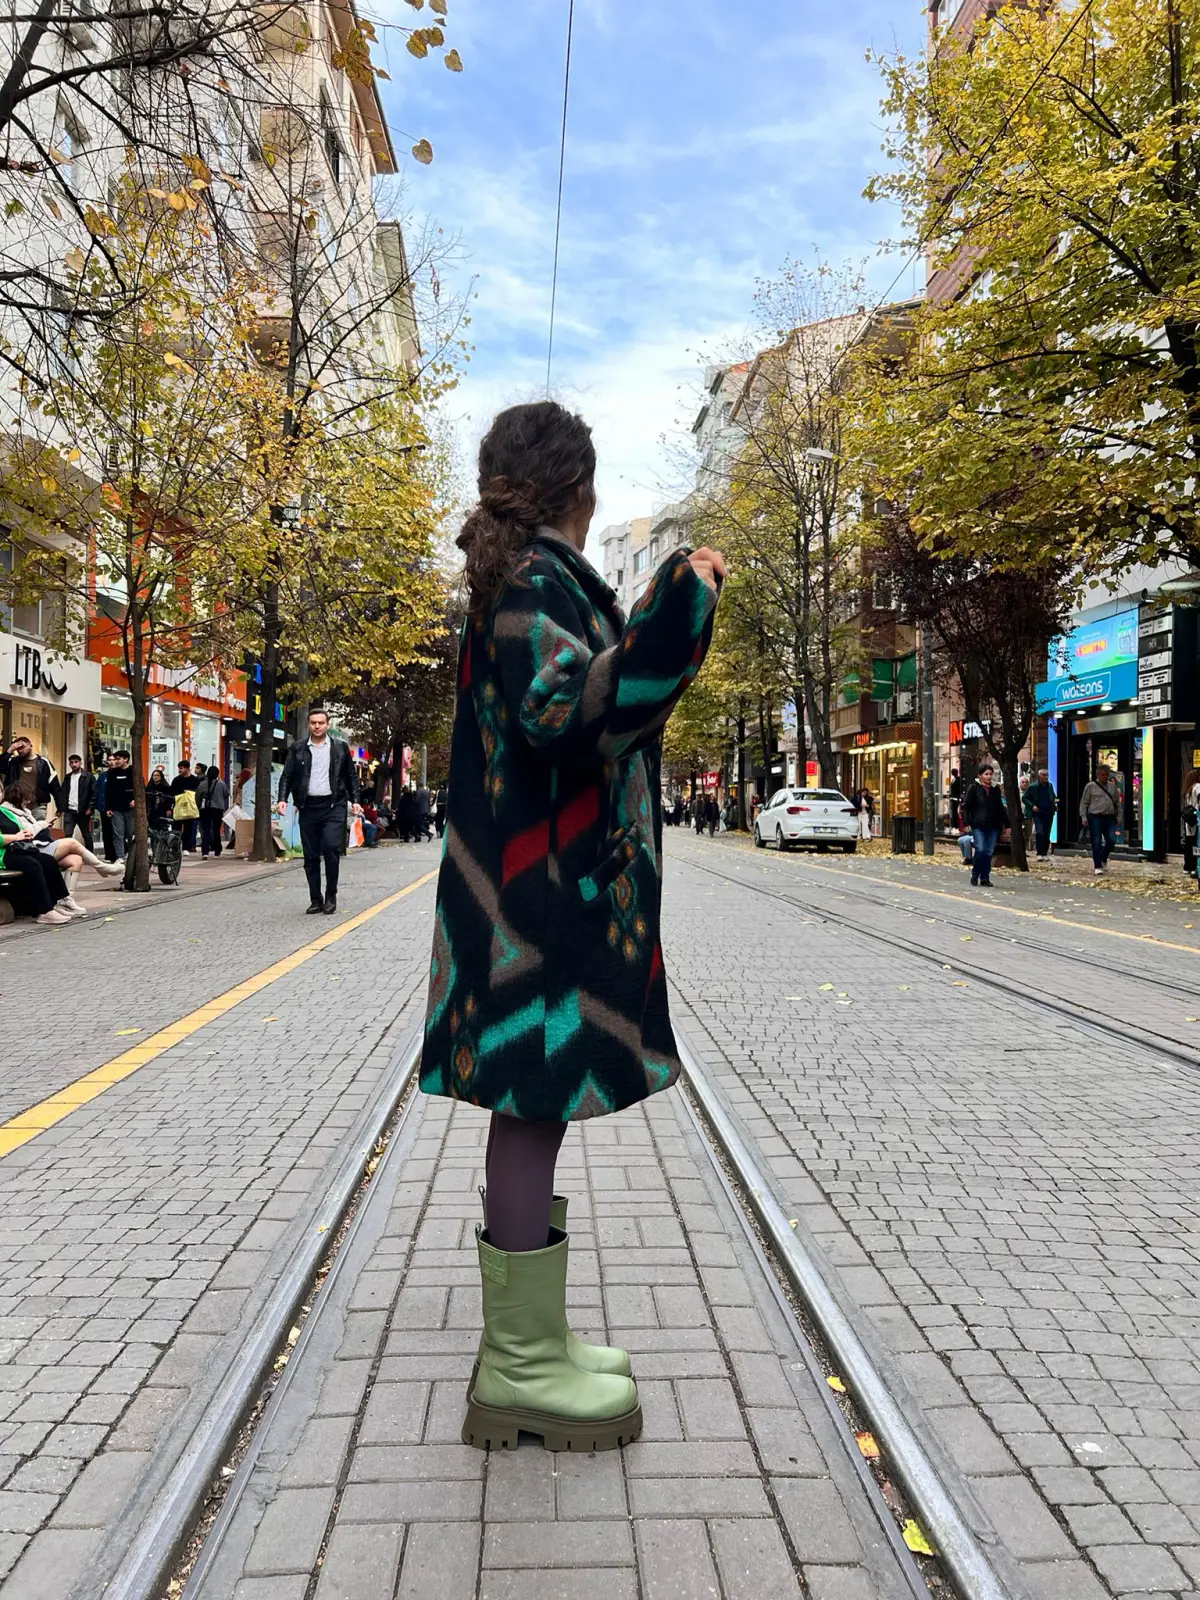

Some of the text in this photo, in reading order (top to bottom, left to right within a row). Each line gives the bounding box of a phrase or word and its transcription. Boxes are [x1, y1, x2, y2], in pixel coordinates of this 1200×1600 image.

[15, 643, 41, 690] LTB
[1062, 680, 1103, 700] watsons
[20, 712, 40, 729] LTB
